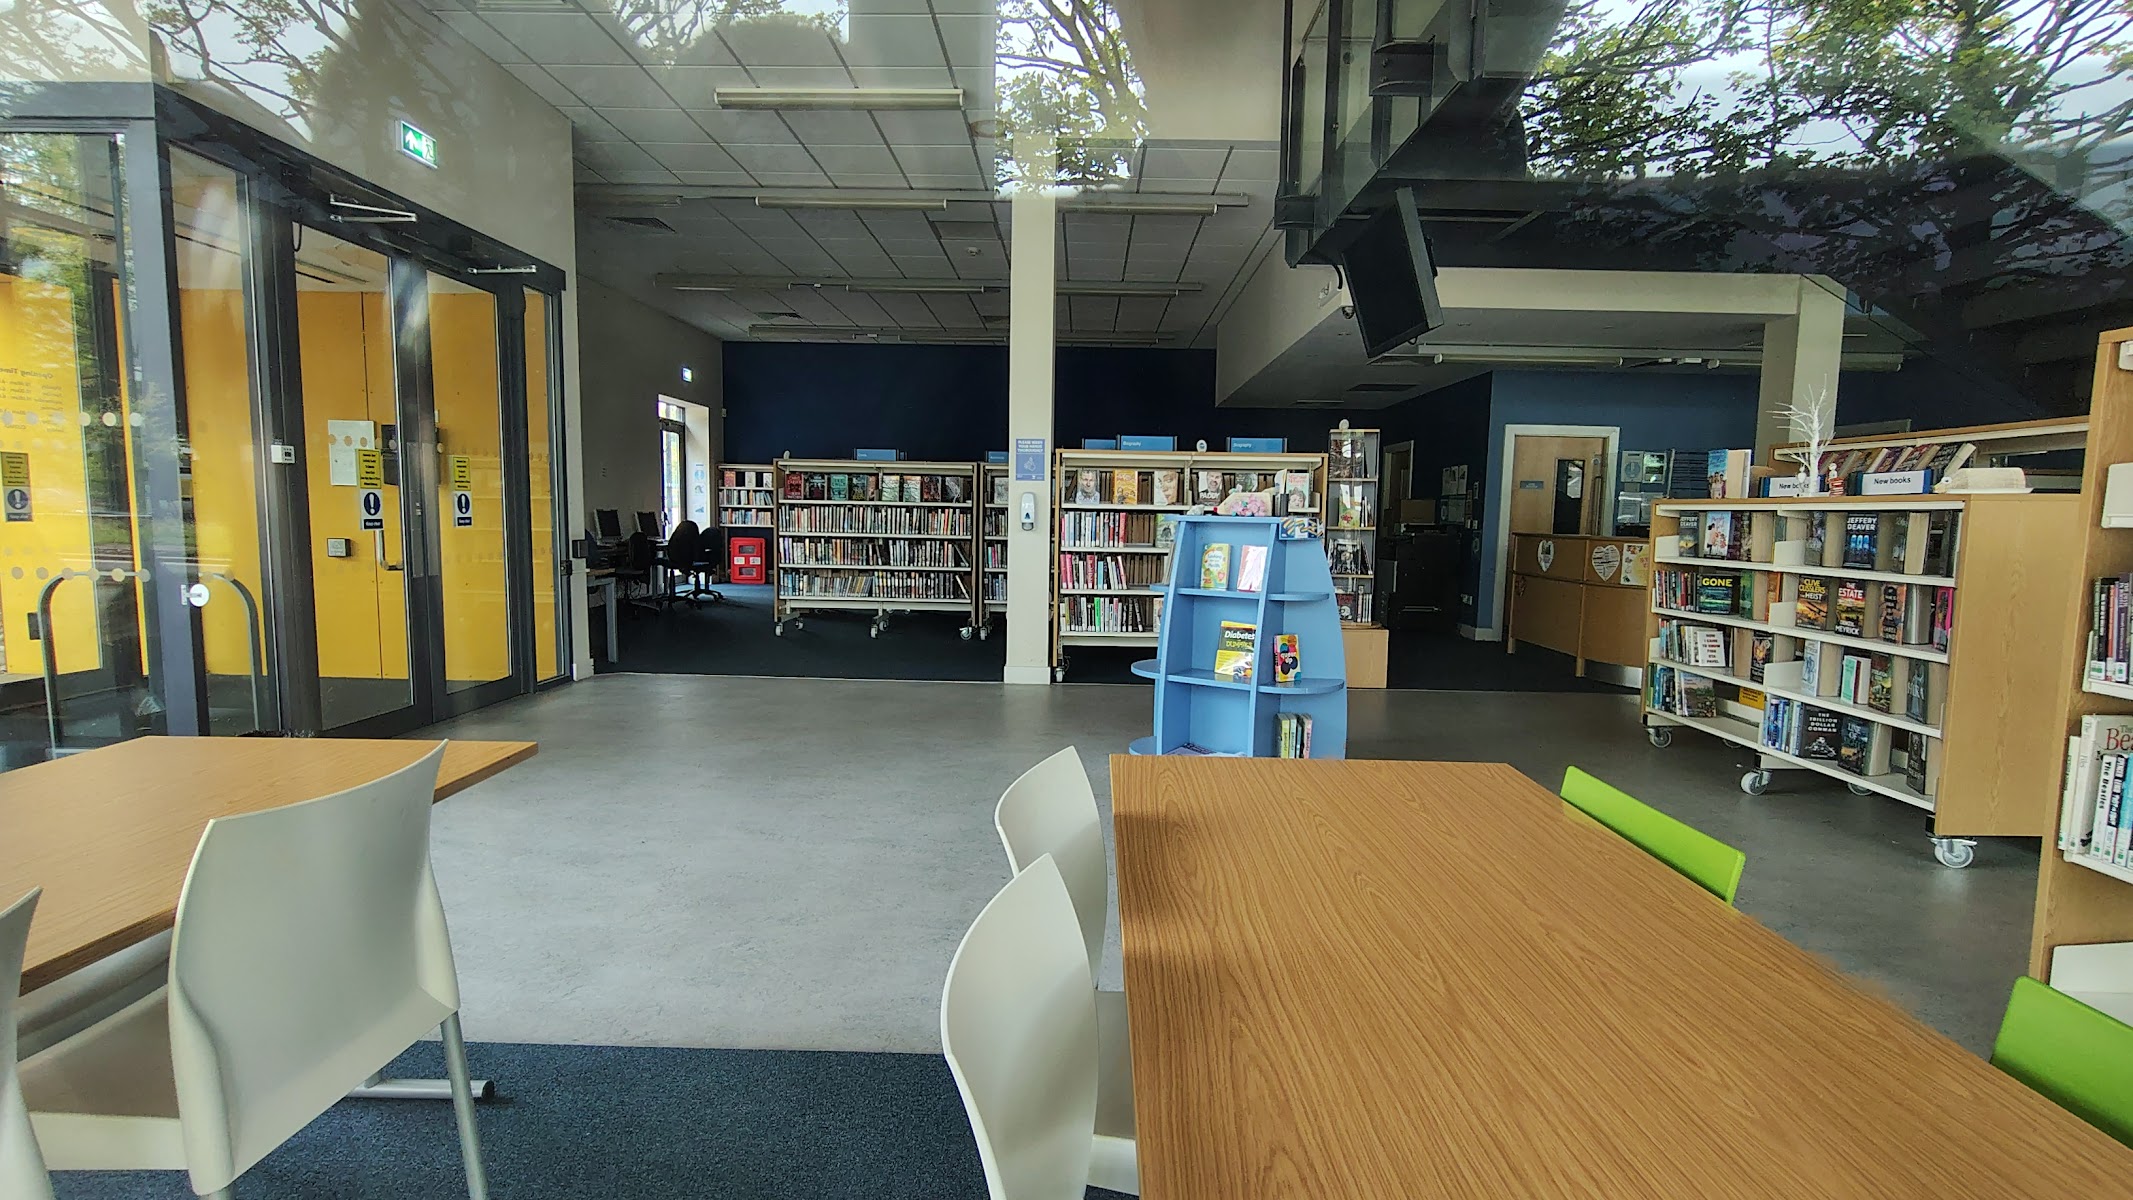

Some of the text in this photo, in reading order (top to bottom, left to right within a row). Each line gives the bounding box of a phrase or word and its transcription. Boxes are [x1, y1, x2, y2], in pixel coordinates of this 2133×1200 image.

[1122, 440, 1142, 448] Biography
[1889, 476, 1911, 485] books
[1847, 523, 1876, 531] DEAVER
[1702, 577, 1733, 587] GONE
[1804, 578, 1821, 587] CLIVE
[1805, 592, 1823, 600] HEIST
[1838, 587, 1864, 599] ESTATE
[1835, 624, 1860, 635] MEYRICK
[1224, 630, 1255, 640] Diabetes
[2099, 761, 2112, 809] The Beatles
